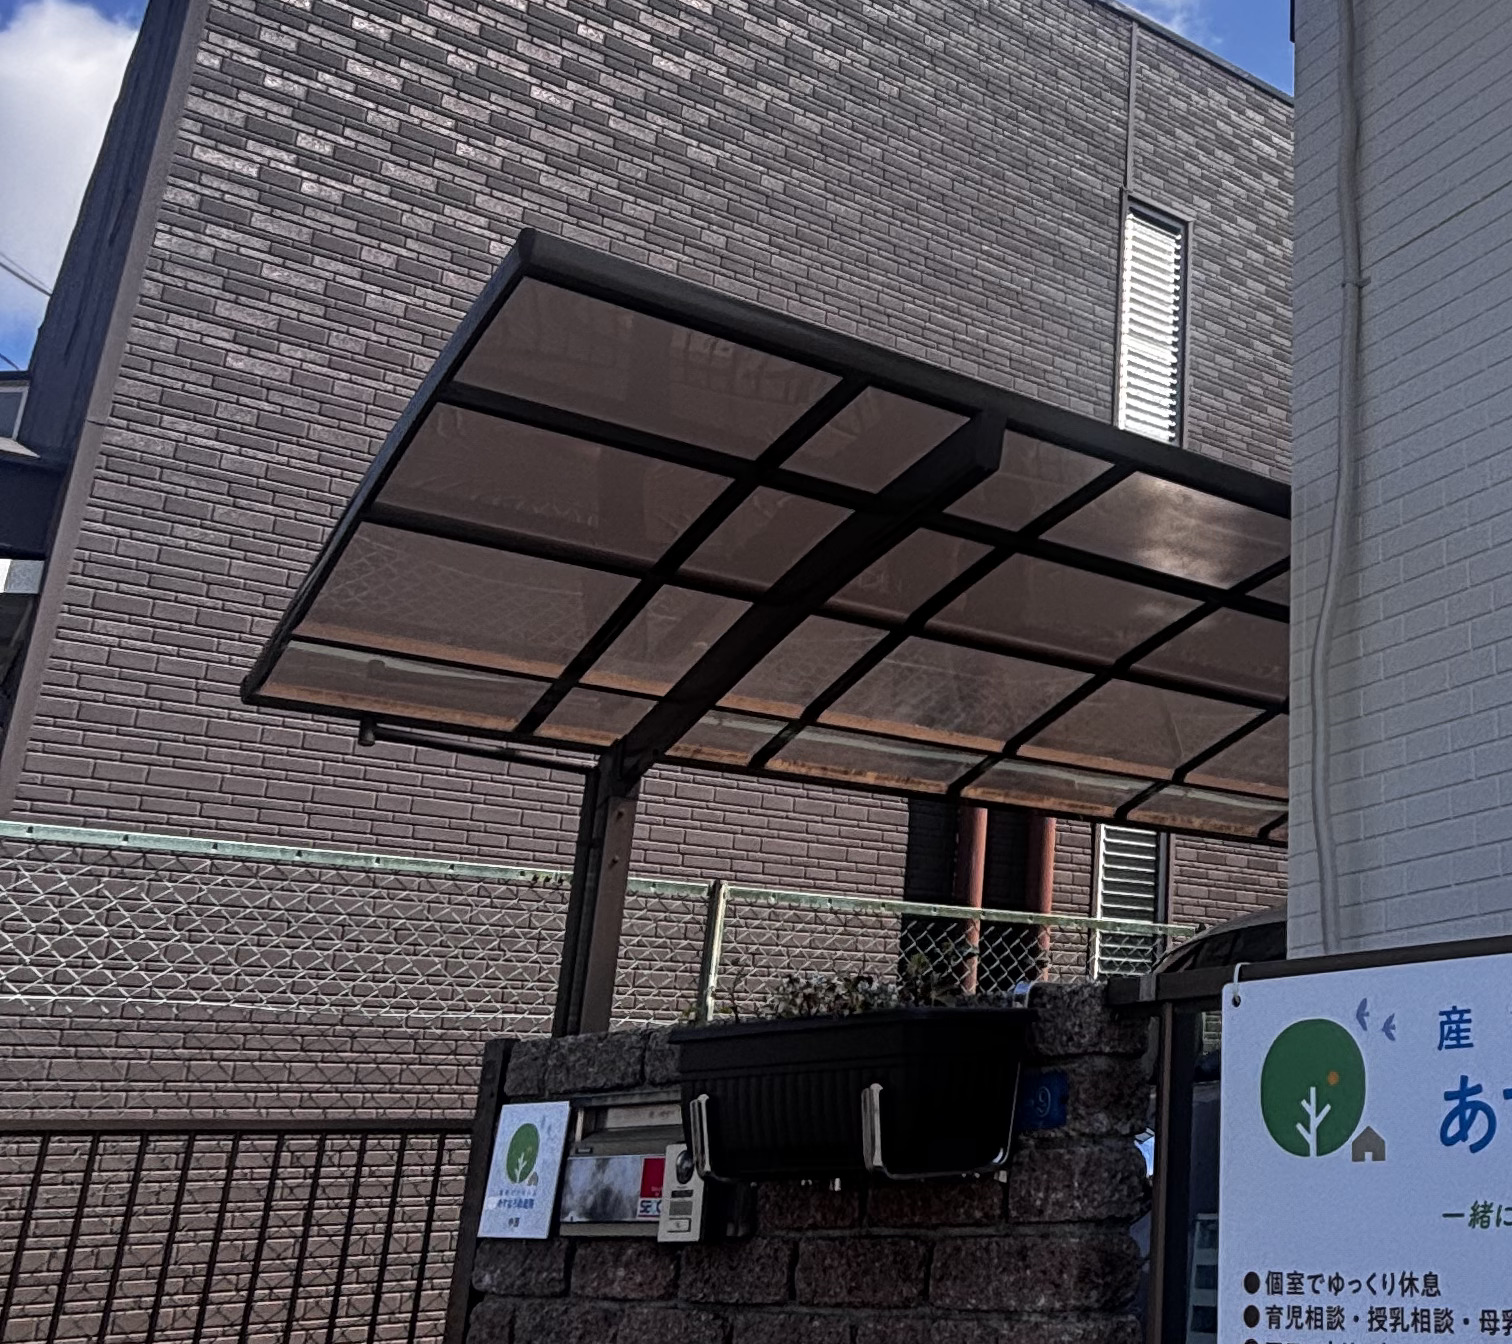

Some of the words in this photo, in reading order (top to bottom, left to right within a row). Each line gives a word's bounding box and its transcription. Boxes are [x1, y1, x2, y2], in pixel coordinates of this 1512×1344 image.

[1264, 1270, 1442, 1298] 個室でゆっくり休息
